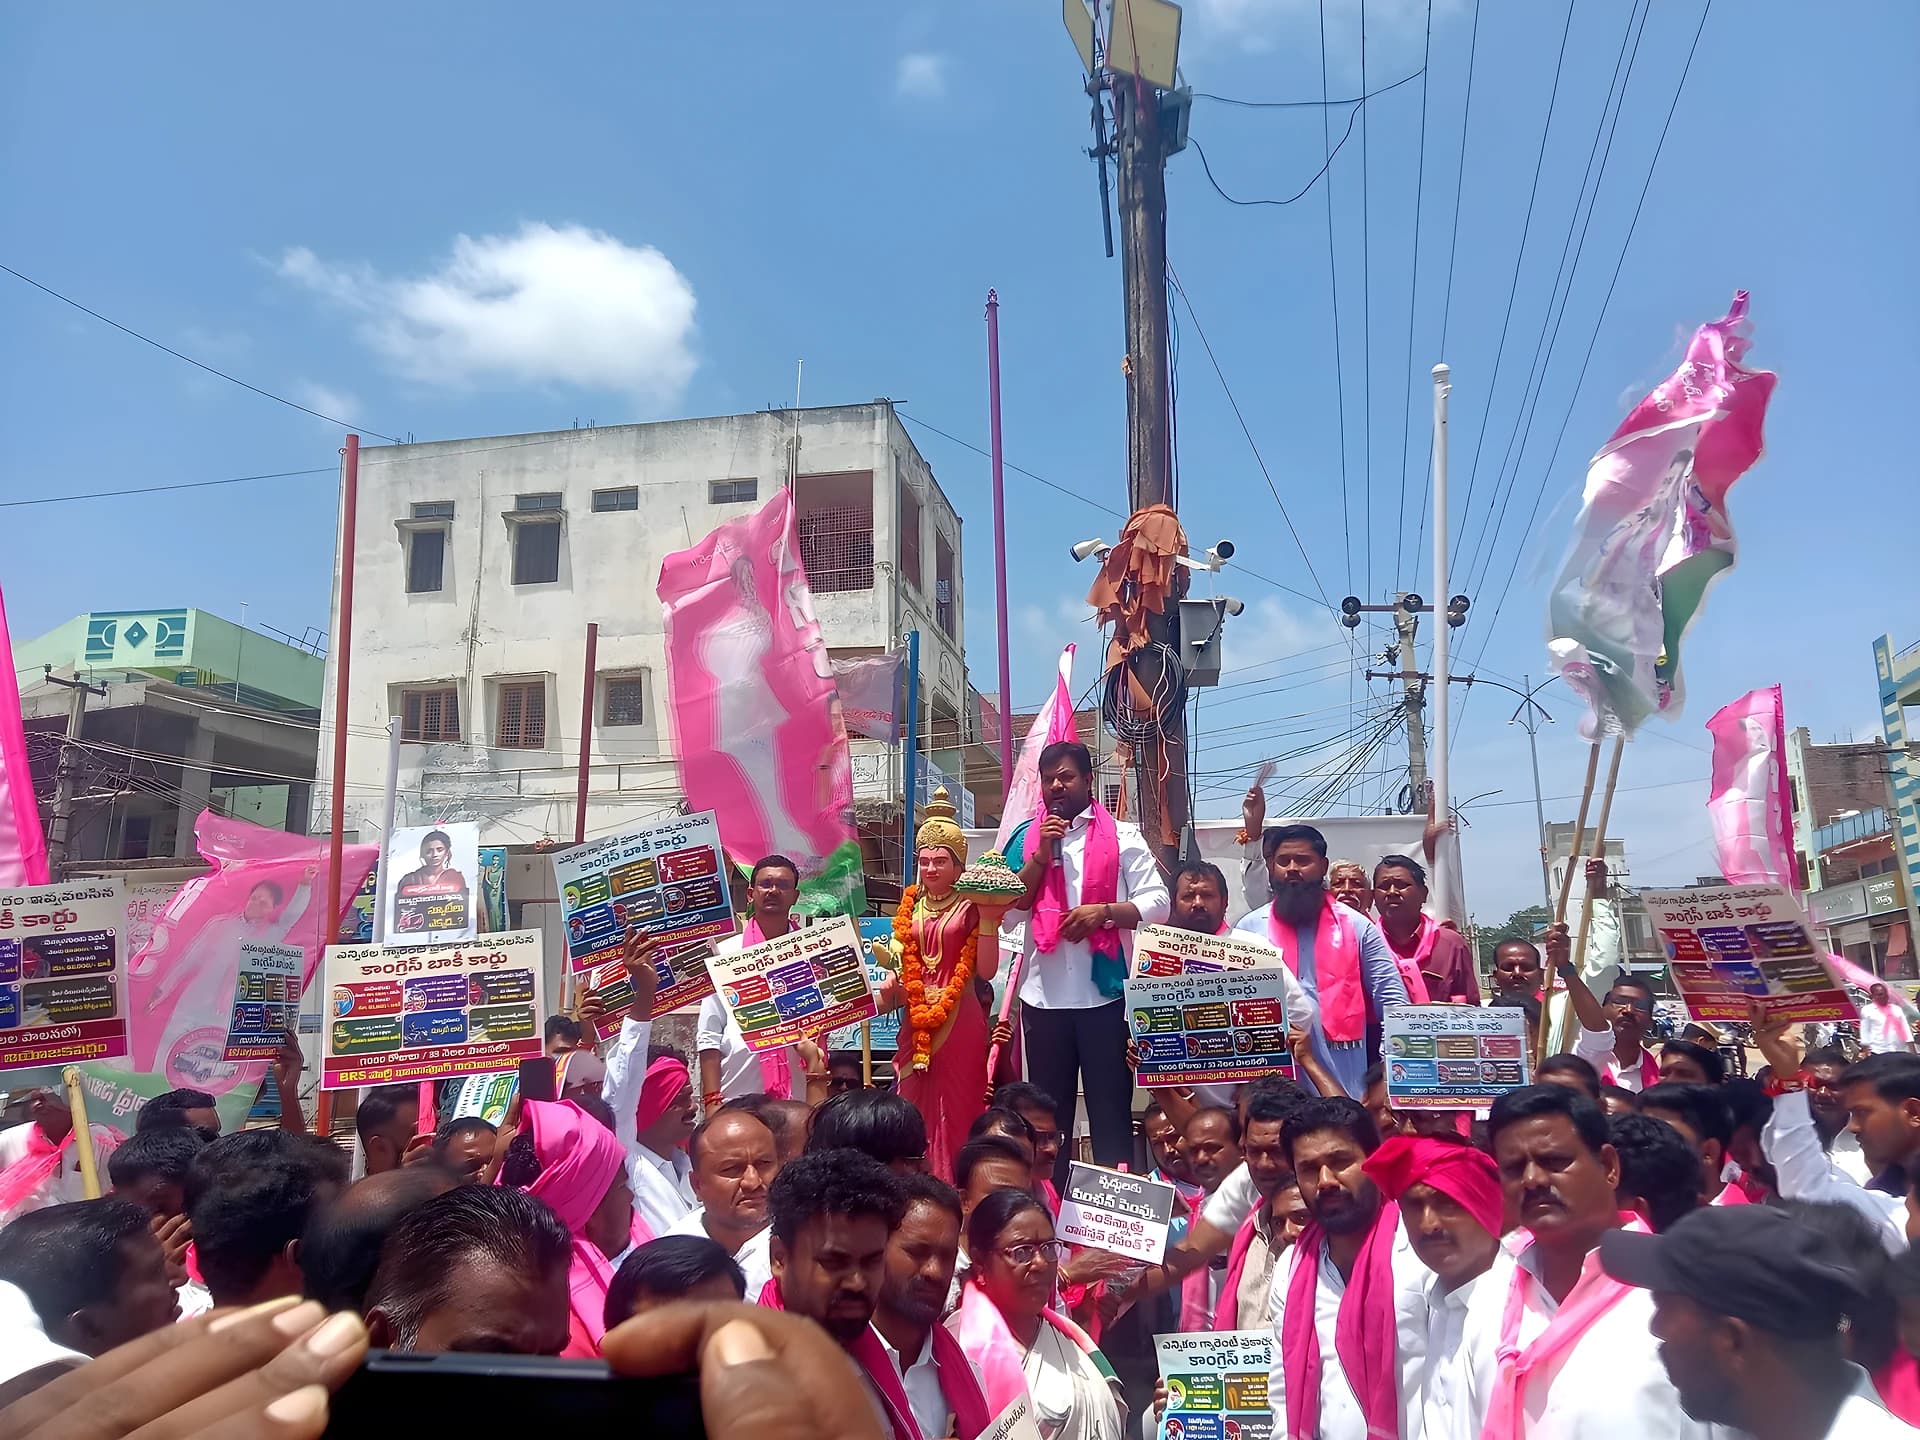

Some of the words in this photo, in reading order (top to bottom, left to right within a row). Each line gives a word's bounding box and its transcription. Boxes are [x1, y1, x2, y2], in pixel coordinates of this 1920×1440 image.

[579, 851, 622, 872] కాంగ్రెస్
[623, 842, 650, 858] బాకీ
[654, 834, 687, 851] కార్డు
[31, 887, 114, 905] ఇవ్వవలసిన
[21, 909, 78, 931] కార్డు
[1664, 907, 1704, 924] కాంగ్రెస్
[1705, 903, 1734, 920] బాకీ
[1735, 903, 1772, 921] కార్డు
[336, 949, 378, 961] ఎన్నికల
[733, 955, 775, 975] కాంగ్రెస్
[777, 945, 803, 962] బాకీ
[804, 937, 833, 952] కార్డు
[1158, 940, 1199, 958] కాంగ్రెస్
[1201, 947, 1225, 960] బాకీ
[1228, 952, 1256, 968] కార్డు
[361, 957, 423, 976] కాంగ్రెస్
[428, 953, 463, 969] బాకీ
[468, 952, 508, 969] కార్డు
[1151, 987, 1196, 1003] కాంగ్రెస్
[1198, 985, 1225, 998] బాకీ
[1228, 984, 1257, 1001] కార్డు
[21, 1026, 81, 1043] పాలనలో)
[338, 1069, 367, 1082] BRS
[1099, 1175, 1142, 1193] వృద్ధులకు
[1162, 1340, 1197, 1352] ఎన్నికల
[1188, 1350, 1239, 1369] కాంగ్రెస్
